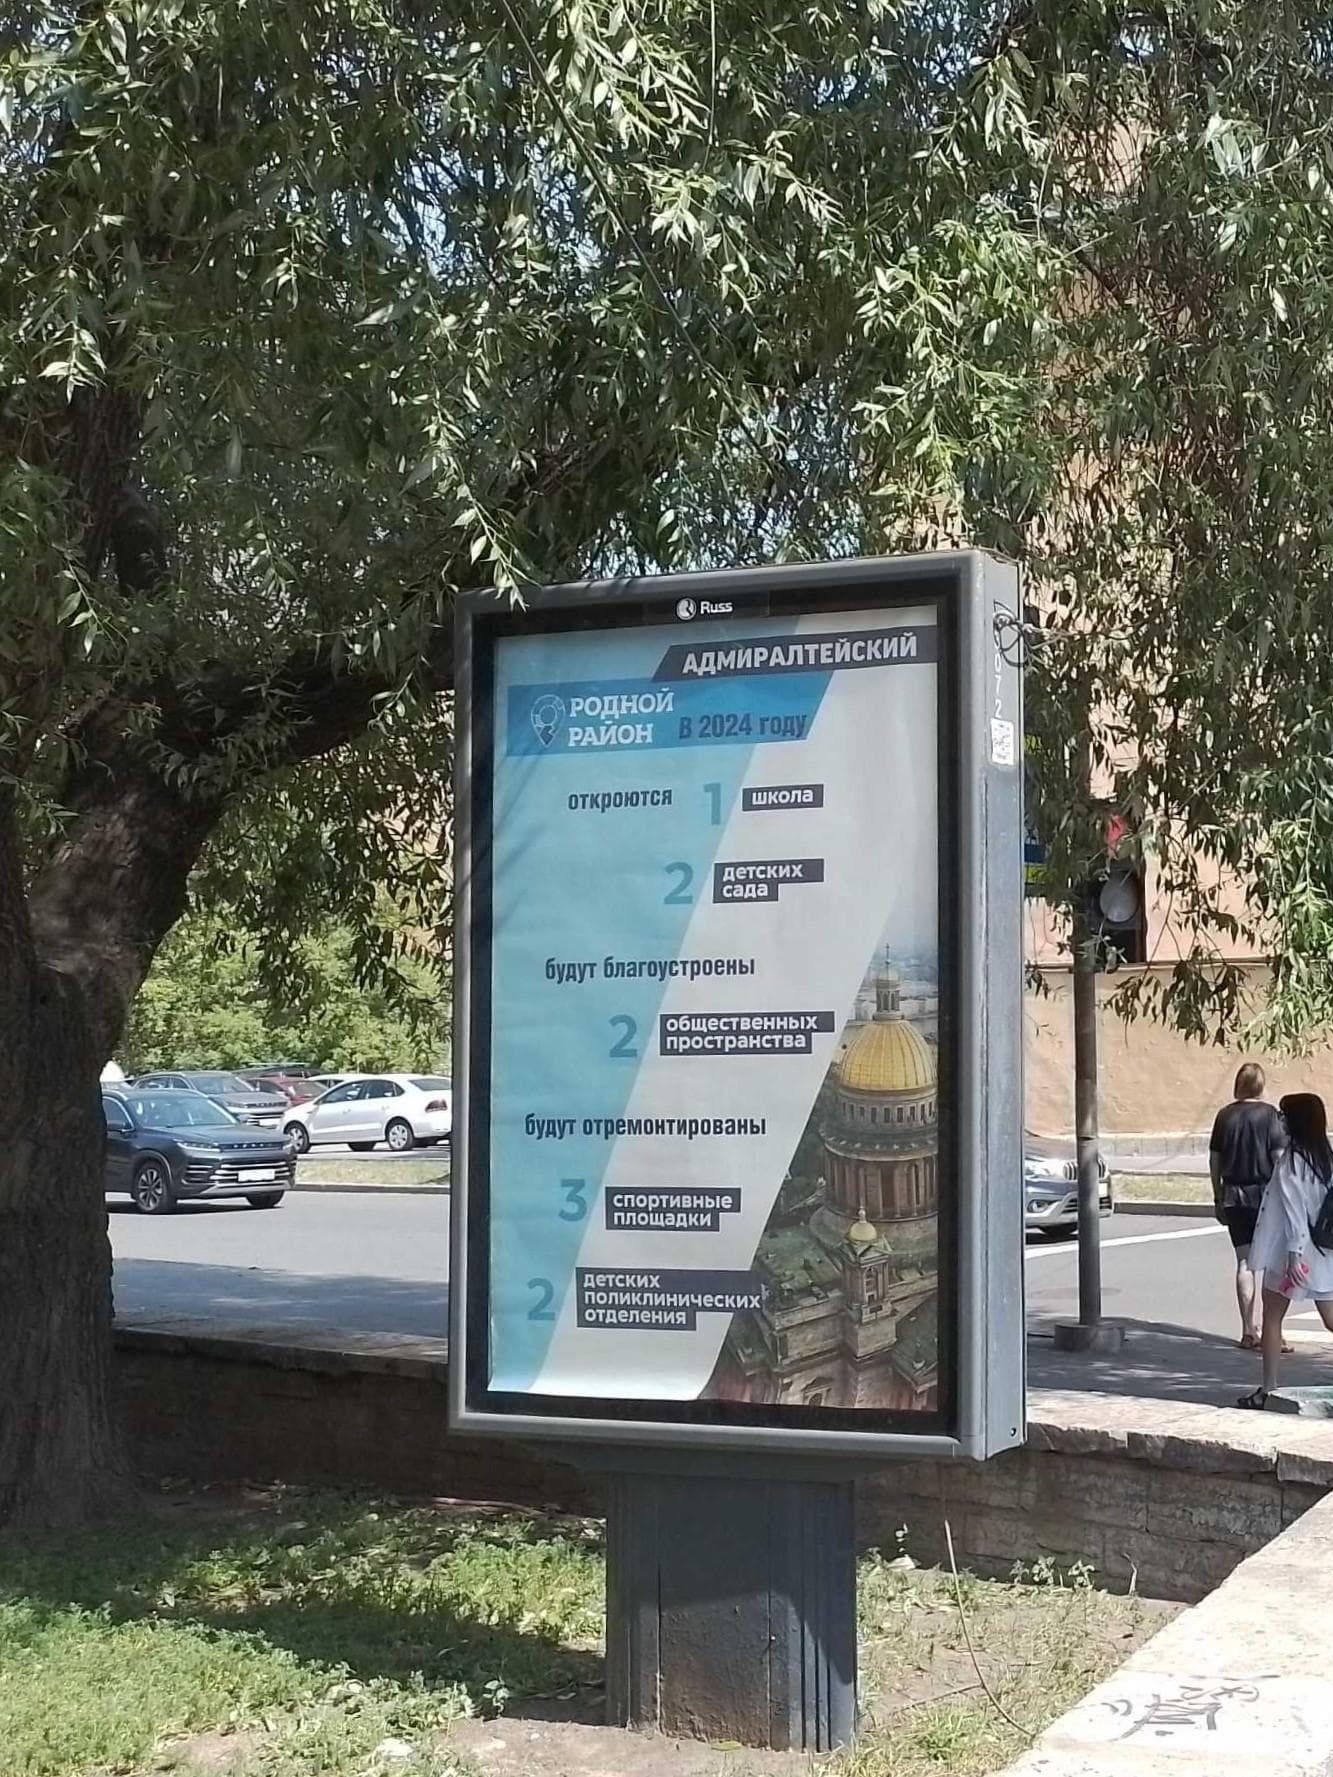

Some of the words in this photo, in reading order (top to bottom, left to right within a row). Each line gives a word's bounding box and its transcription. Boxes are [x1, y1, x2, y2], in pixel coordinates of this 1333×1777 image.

[701, 601, 733, 614] Russ
[682, 632, 917, 676] АДМИРАЛТЕЙСКИЙ
[570, 687, 674, 717] РОДНОЙ
[567, 720, 653, 748] РАЙОН
[699, 713, 752, 739] 2024
[759, 714, 807, 739] году
[568, 789, 673, 813] откроются
[703, 782, 722, 826] 1
[752, 788, 814, 806] школа
[663, 861, 694, 905] 2
[722, 864, 803, 882] детских
[722, 882, 769, 899] сада
[545, 957, 597, 984] будут
[603, 956, 755, 982] благоустроены
[608, 1014, 638, 1058] 2
[666, 1015, 818, 1033] общественных
[666, 1032, 806, 1052] пространства
[525, 1113, 577, 1140] будут
[582, 1117, 766, 1140] отремонтированы
[558, 1178, 588, 1222] 3
[613, 1193, 733, 1212] спортивные
[613, 1211, 712, 1229] площадки
[583, 1273, 660, 1289] детских
[527, 1277, 556, 1321] 2
[584, 1290, 761, 1309] поликлинических
[585, 1308, 686, 1325] отделения
